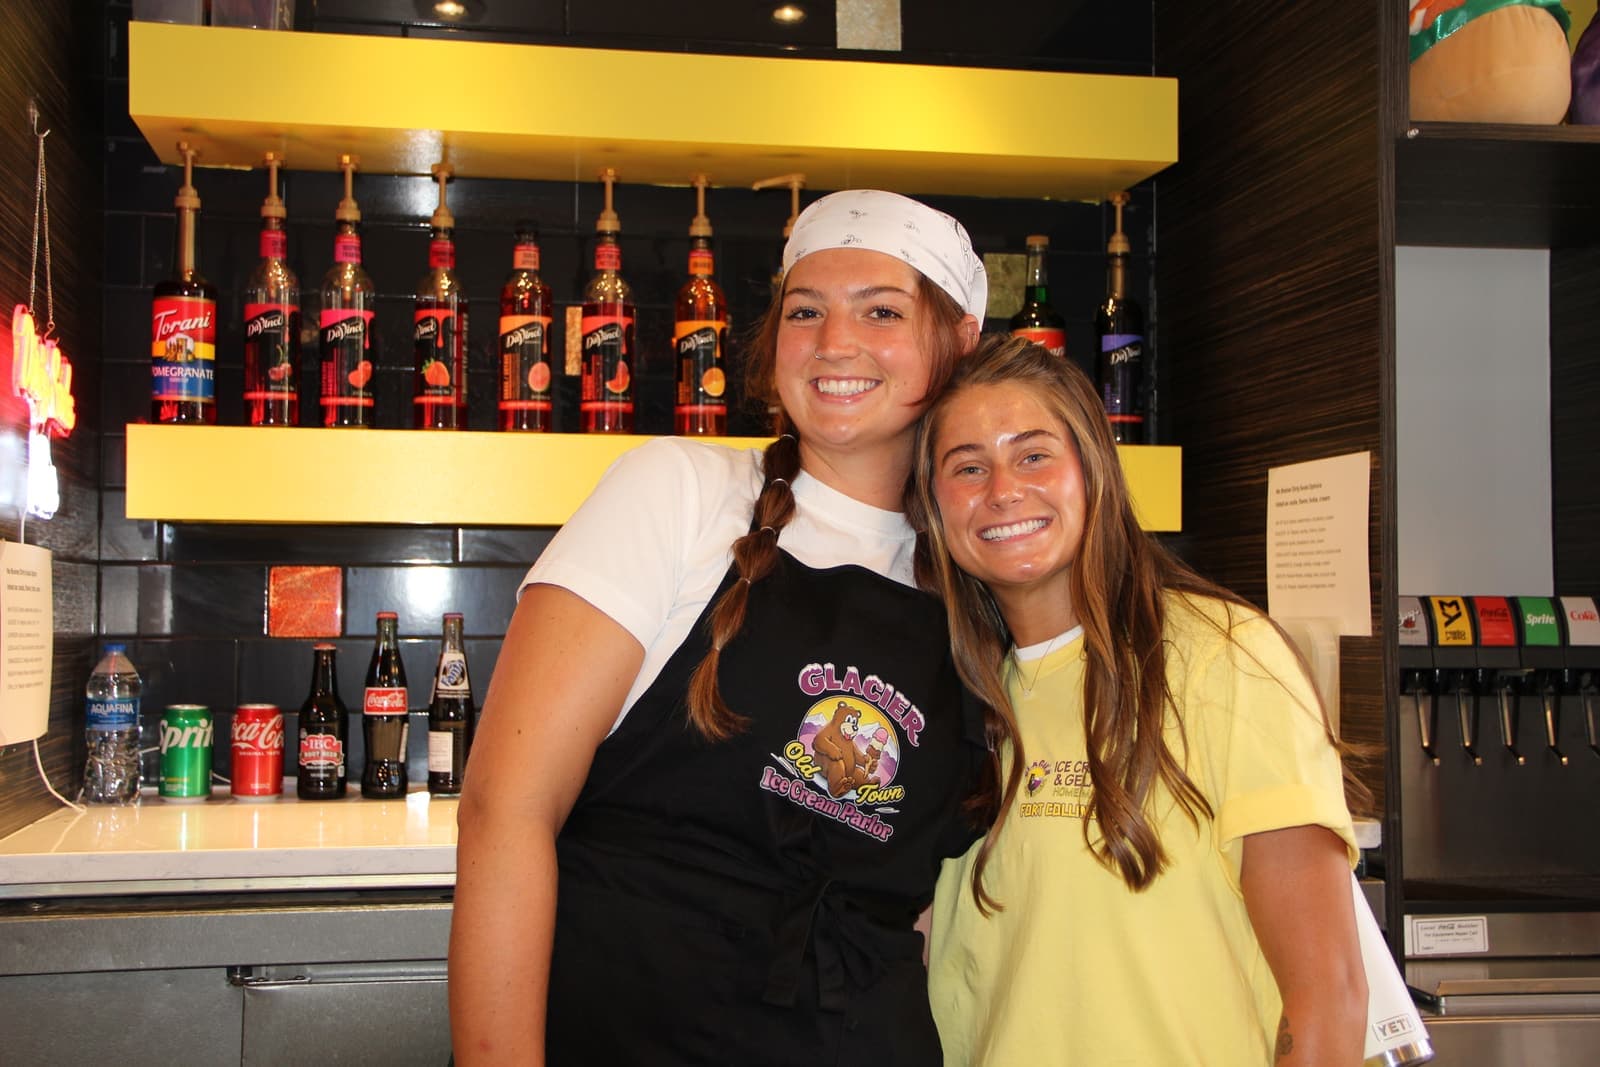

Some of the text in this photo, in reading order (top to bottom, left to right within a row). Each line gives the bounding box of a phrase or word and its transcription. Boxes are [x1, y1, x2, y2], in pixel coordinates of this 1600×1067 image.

[154, 309, 211, 341] Torani
[248, 313, 284, 337] DaVinci
[327, 318, 364, 342] DaVinci
[506, 326, 543, 349] DaVinci
[585, 326, 622, 350] DaVinci
[152, 366, 215, 381] OMEGRANATE
[1525, 612, 1556, 627] Sprite
[90, 703, 135, 716] AQUAFINA
[798, 662, 926, 748] GLACIER
[159, 718, 214, 755] Sprit
[784, 740, 823, 780] Old
[1054, 761, 1072, 773] ICE
[1053, 774, 1092, 787] & GEL
[760, 766, 893, 842] Ice Cream Parlor
[855, 784, 905, 806] Town
[1020, 802, 1044, 818] FORT
